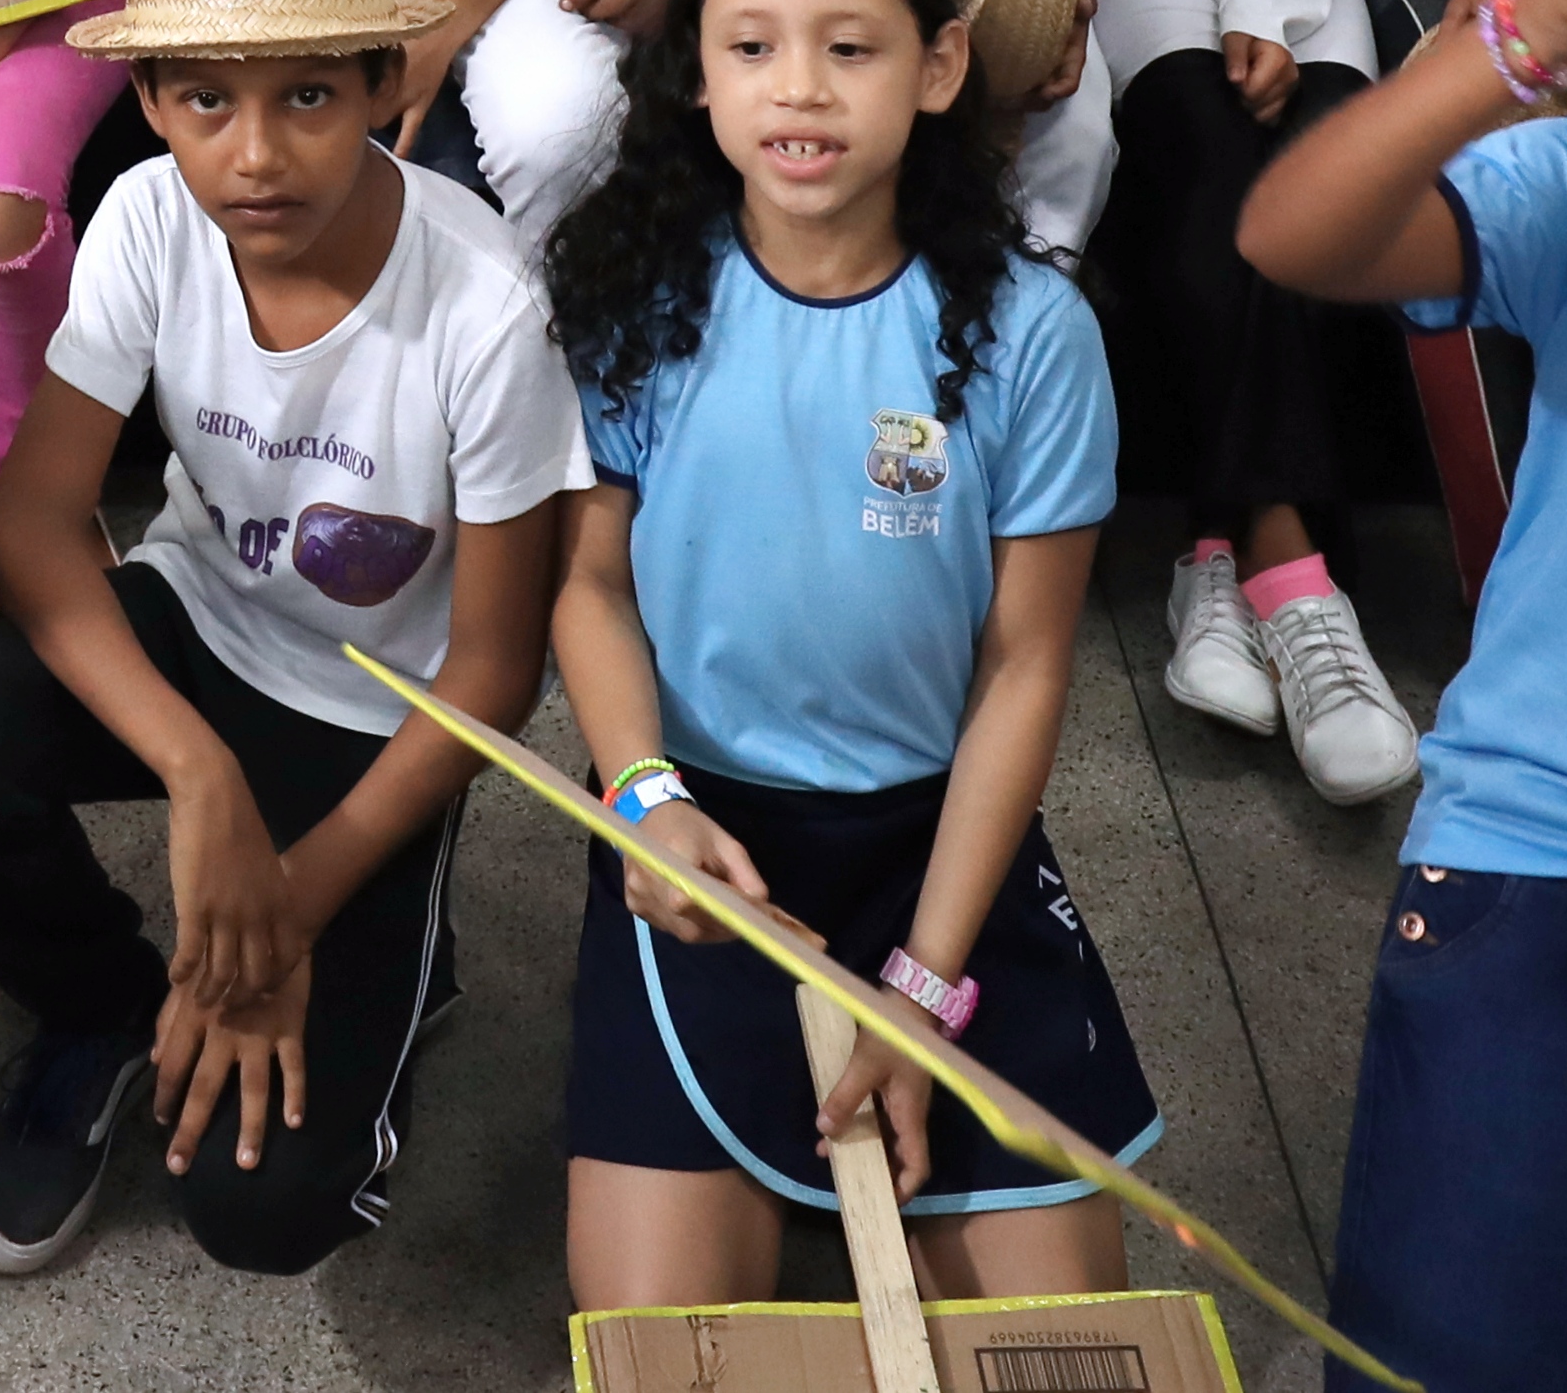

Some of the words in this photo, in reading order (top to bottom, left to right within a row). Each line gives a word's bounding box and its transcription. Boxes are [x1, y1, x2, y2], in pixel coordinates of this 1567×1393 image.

[196, 407, 257, 451] GRUPO
[257, 433, 376, 481] FOLCLÓRICO
[861, 508, 941, 538] BELÉM
